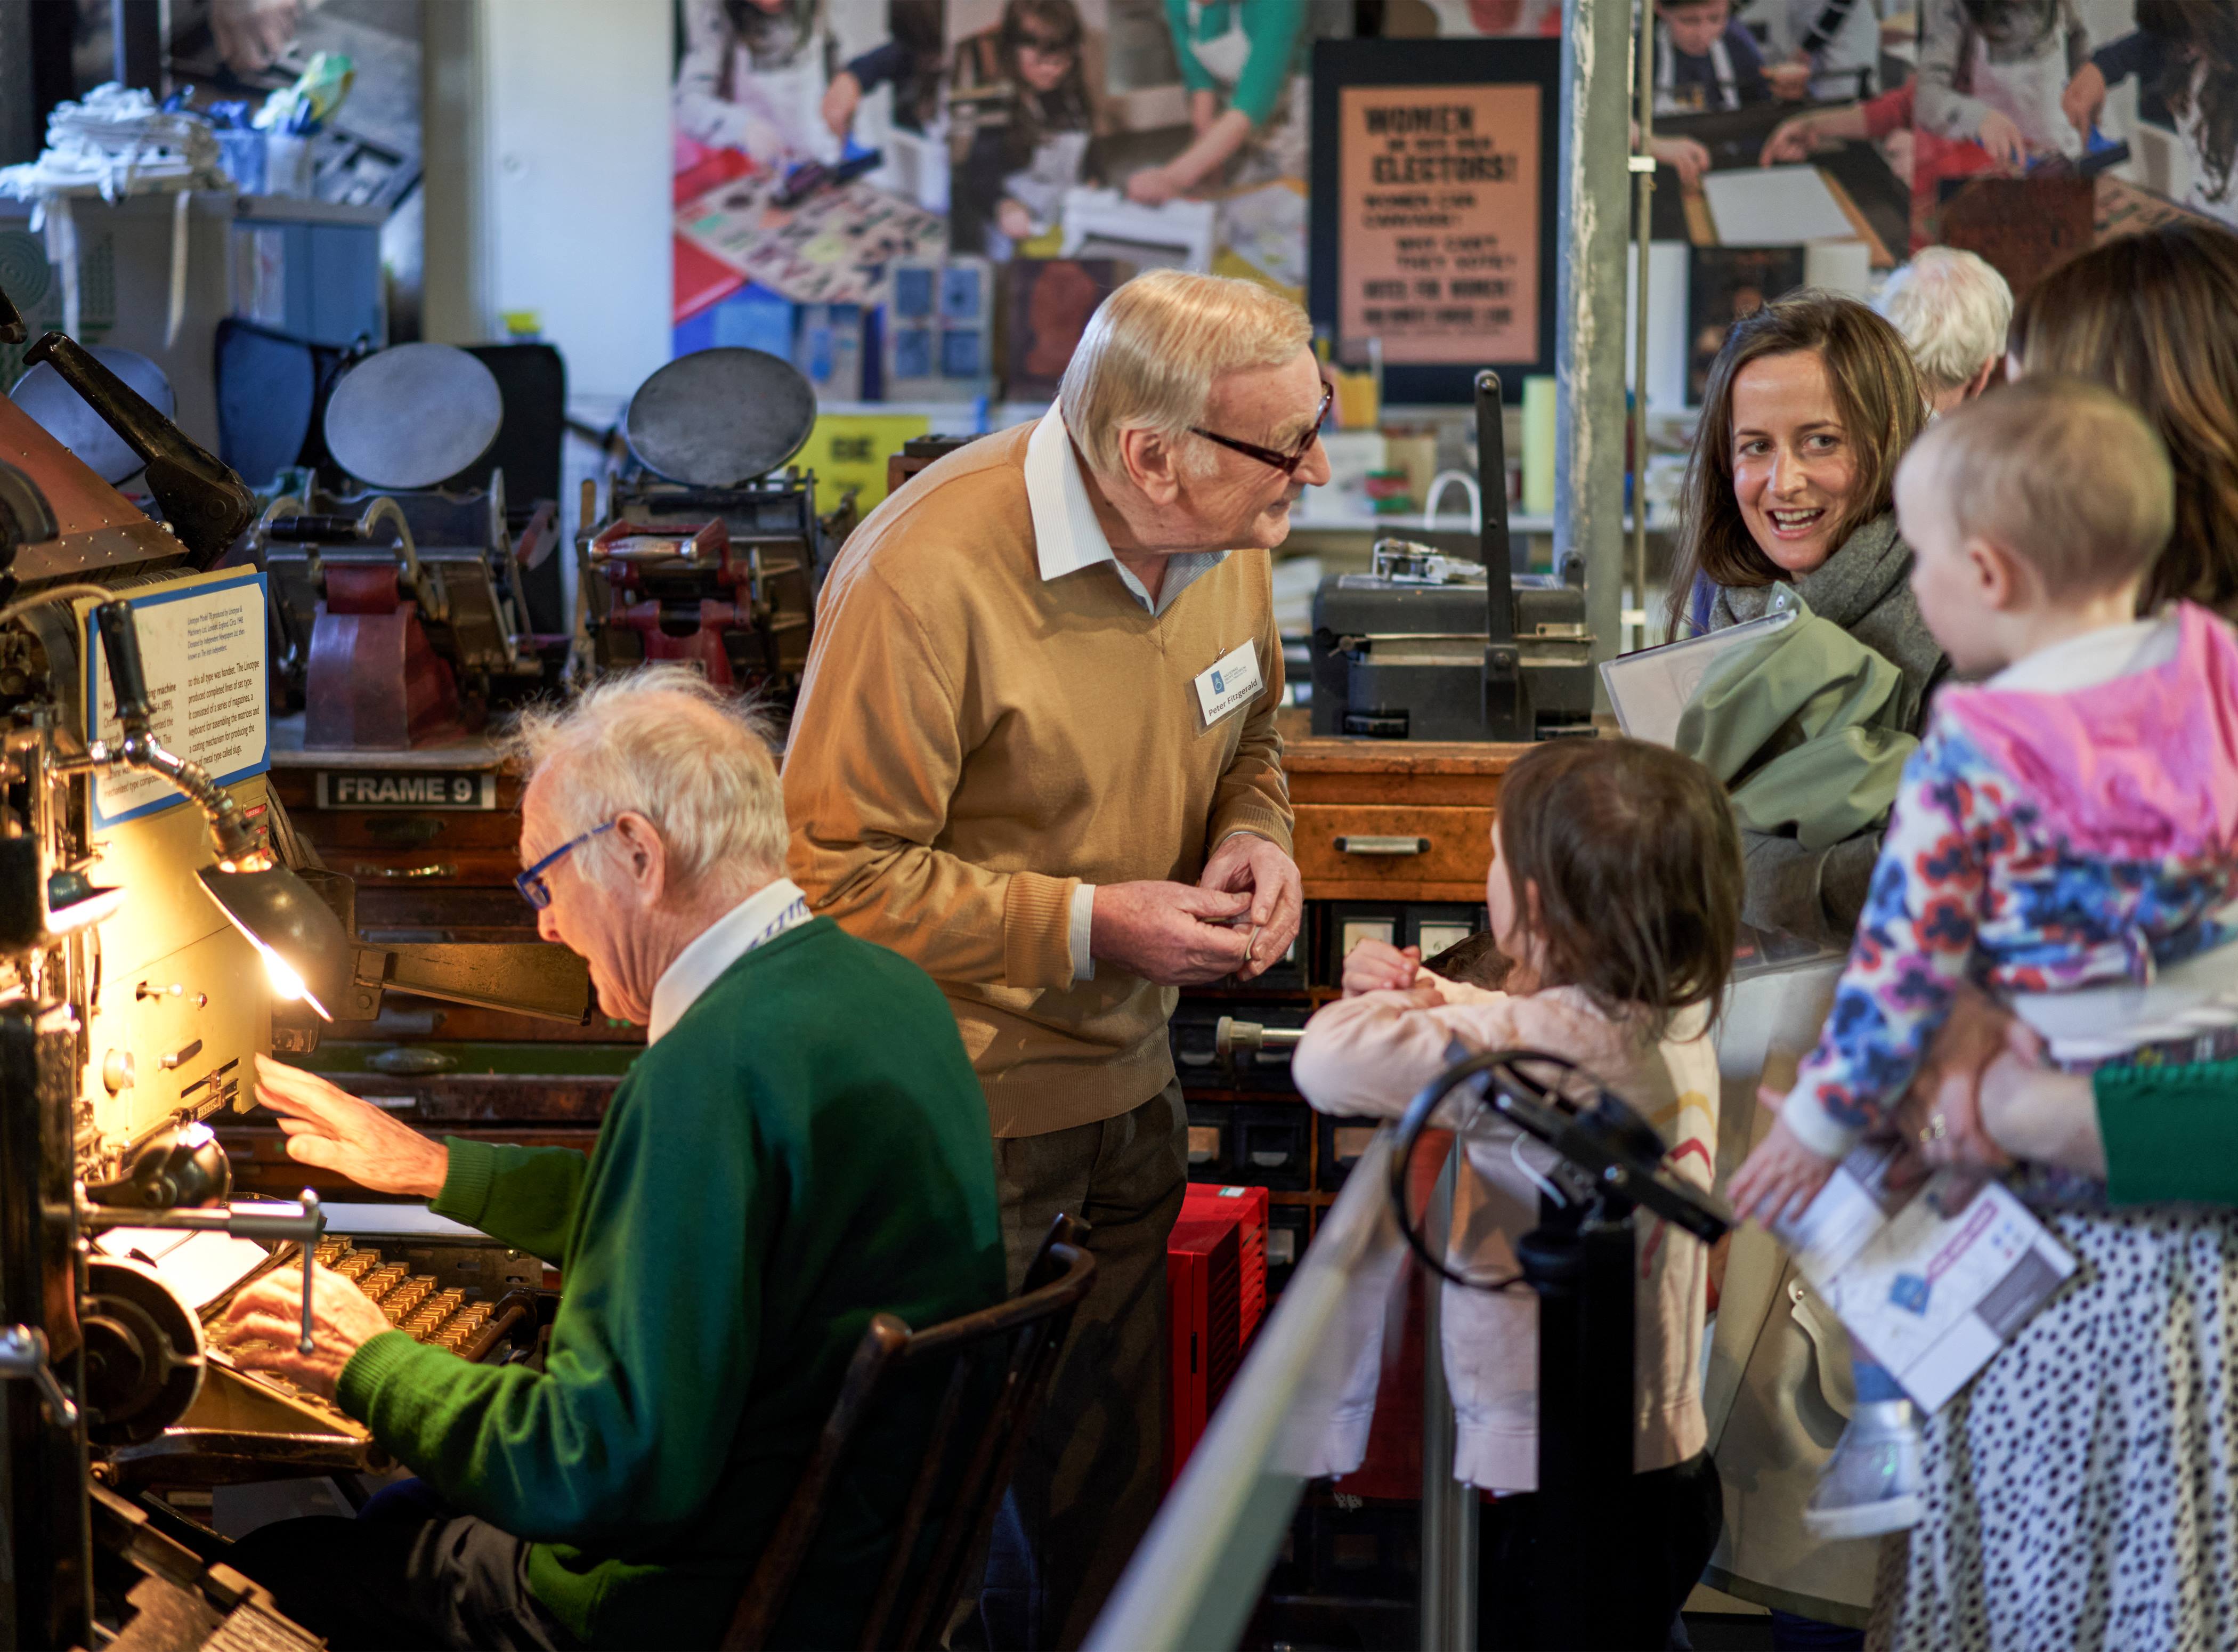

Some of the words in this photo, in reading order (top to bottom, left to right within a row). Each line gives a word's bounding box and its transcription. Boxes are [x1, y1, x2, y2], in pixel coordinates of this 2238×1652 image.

[1364, 104, 1475, 134] WOMEN
[1373, 152, 1518, 184] ELECTORS!
[229, 608, 240, 616] Linotype
[204, 635, 218, 645] Independent
[188, 678, 193, 686] to
[222, 666, 236, 677] handset.
[244, 660, 260, 672] Linotype
[103, 700, 113, 711] Hot
[157, 682, 176, 695] machine
[188, 690, 206, 706] produced
[206, 686, 224, 699] completed
[233, 679, 238, 690] of
[244, 678, 253, 689] type.
[1209, 702, 1227, 717] Peter
[1227, 678, 1258, 704] Fitzgerald
[189, 710, 192, 720] It
[192, 704, 209, 719] consisted
[210, 703, 214, 714] of
[217, 701, 227, 711] series
[228, 697, 232, 708] of
[232, 694, 250, 708] magazines,
[189, 722, 206, 738] keyboard
[212, 715, 231, 729] assembling
[238, 708, 252, 720] matrices
[163, 734, 172, 745] This
[192, 741, 205, 752] casting
[206, 735, 224, 748] mechanism
[231, 726, 248, 741] producing
[198, 756, 202, 767] of
[203, 752, 213, 764] metal
[222, 746, 232, 758] called
[233, 744, 242, 756] slugs.
[129, 781, 139, 793] type
[338, 777, 446, 802] FRAME
[453, 777, 473, 803] 9
